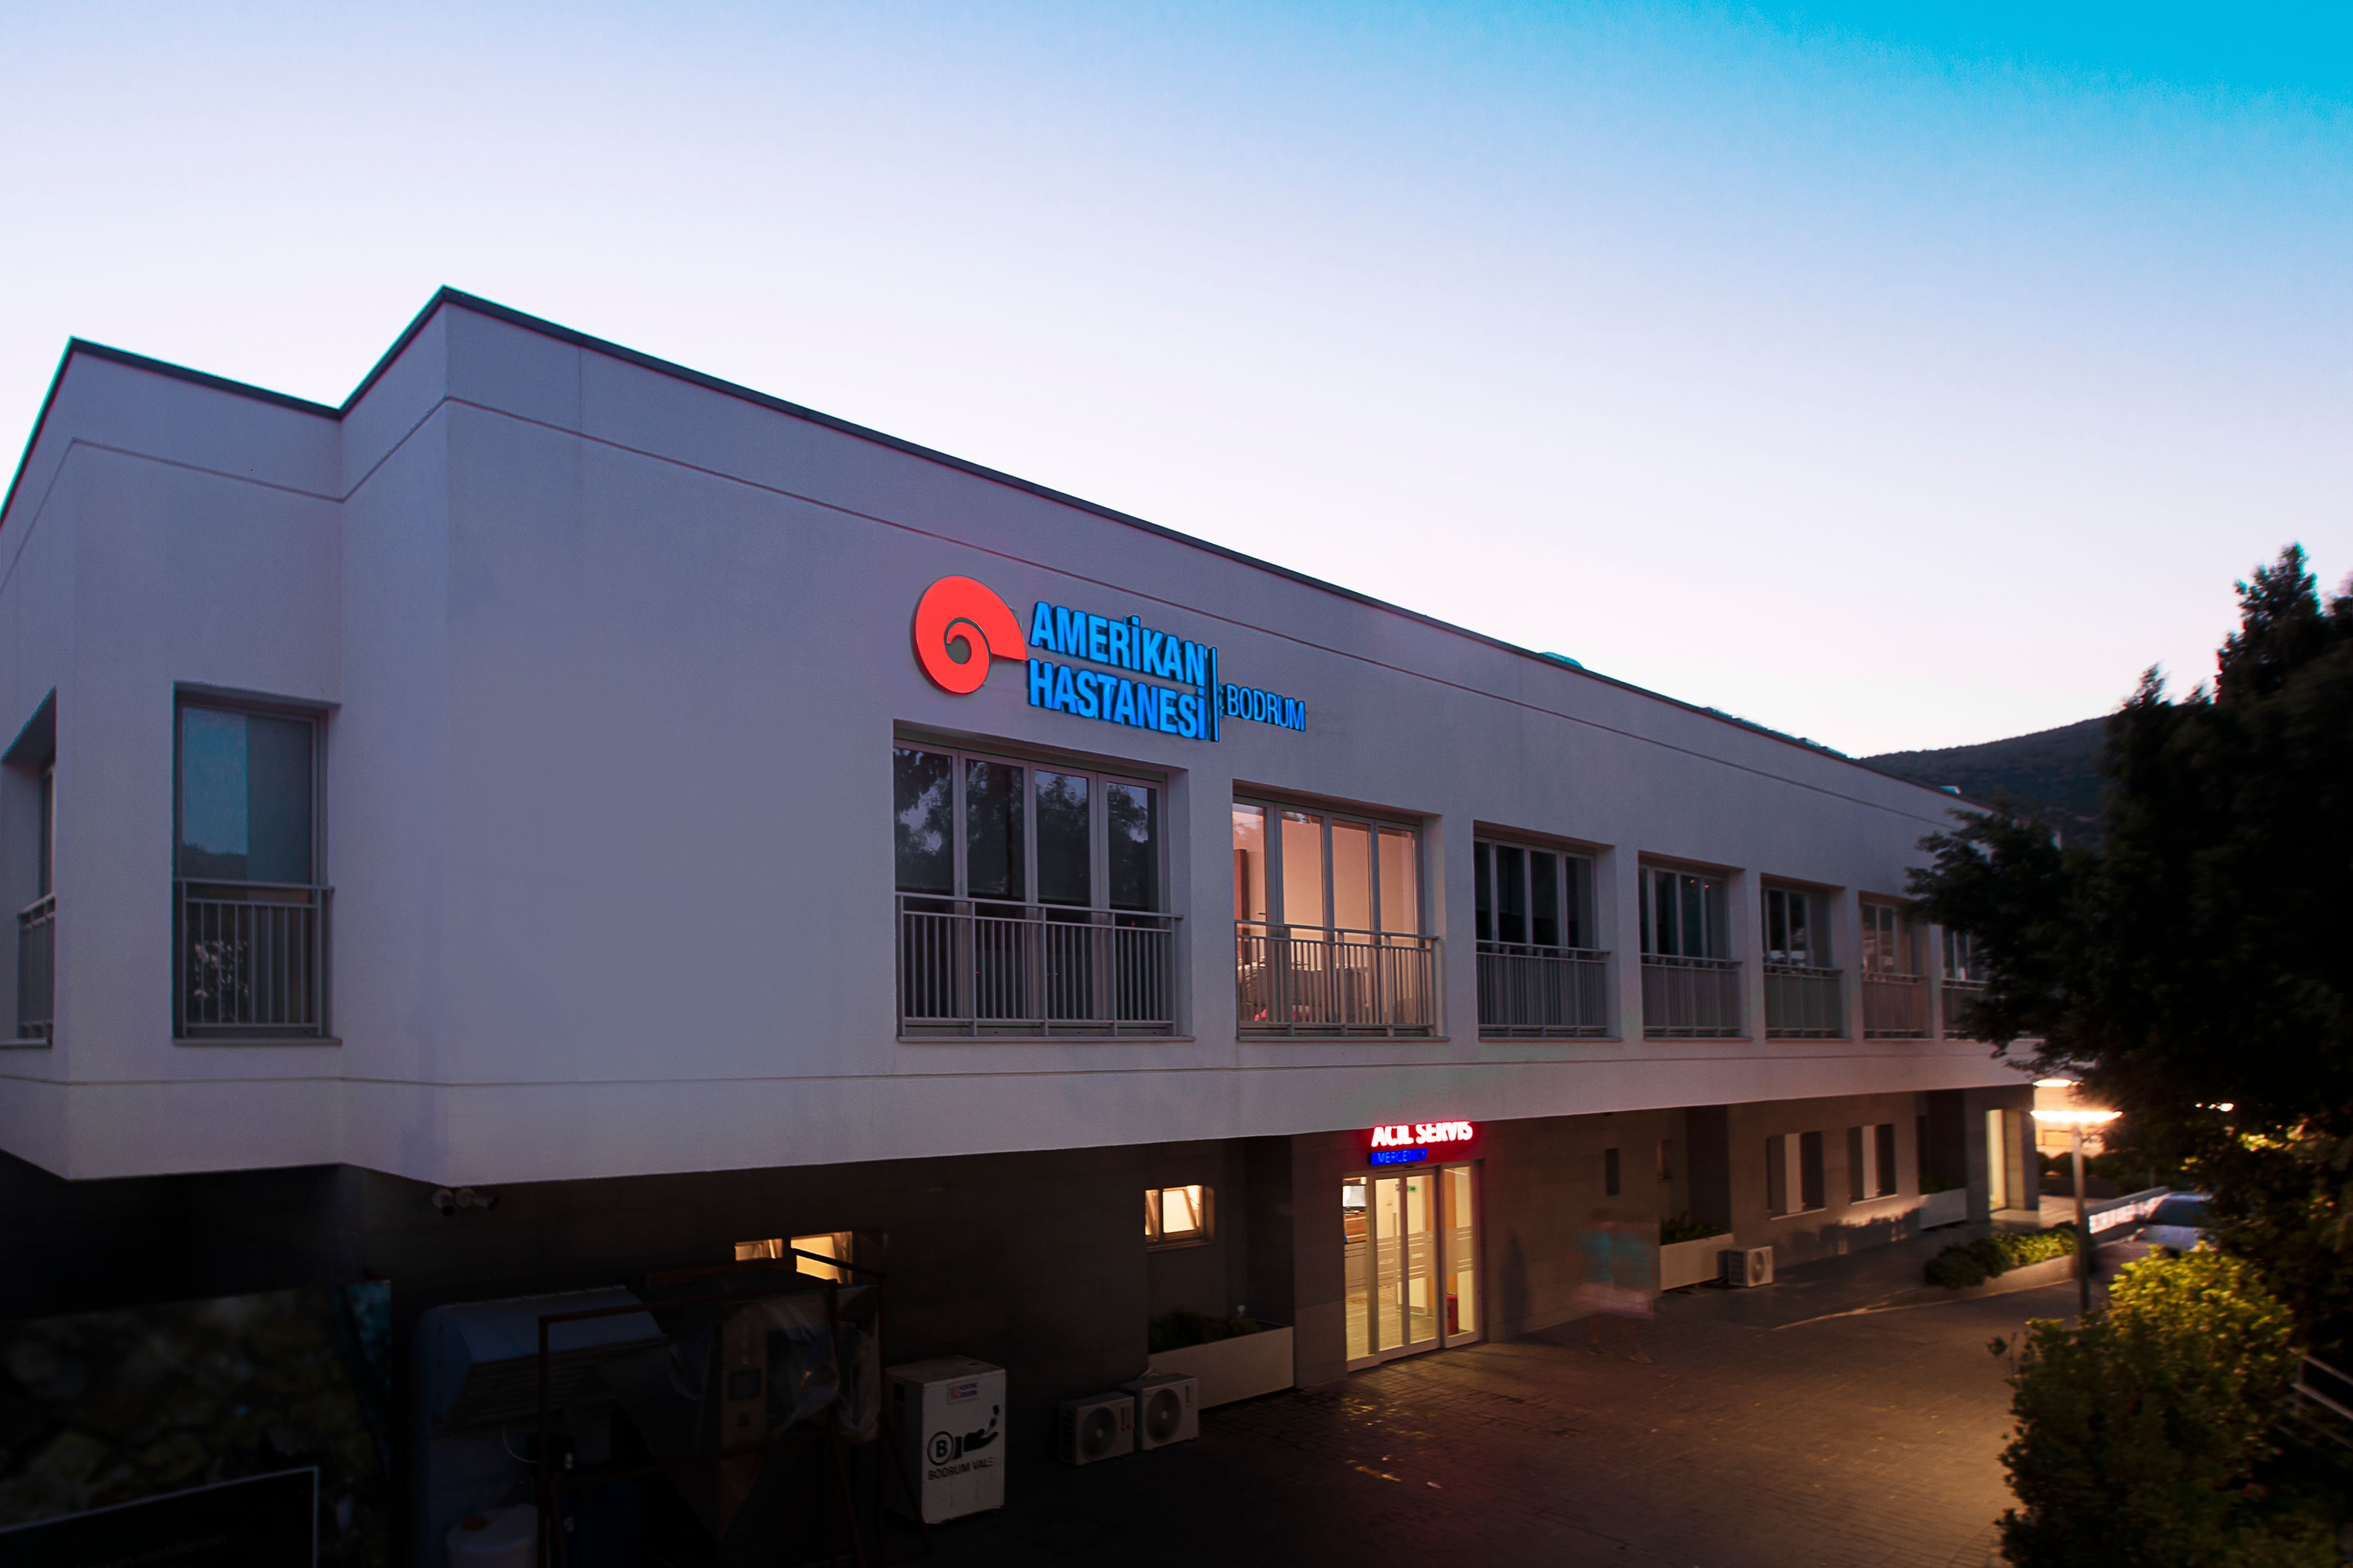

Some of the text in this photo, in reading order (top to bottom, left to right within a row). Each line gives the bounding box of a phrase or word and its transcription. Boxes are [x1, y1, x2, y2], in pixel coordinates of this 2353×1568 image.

[1030, 601, 1206, 687] AMERİKAN
[1029, 658, 1206, 739] HASTANESİ
[1226, 683, 1306, 731] BODRUM
[928, 1462, 971, 1481] BODRUM
[935, 1439, 948, 1458] B
